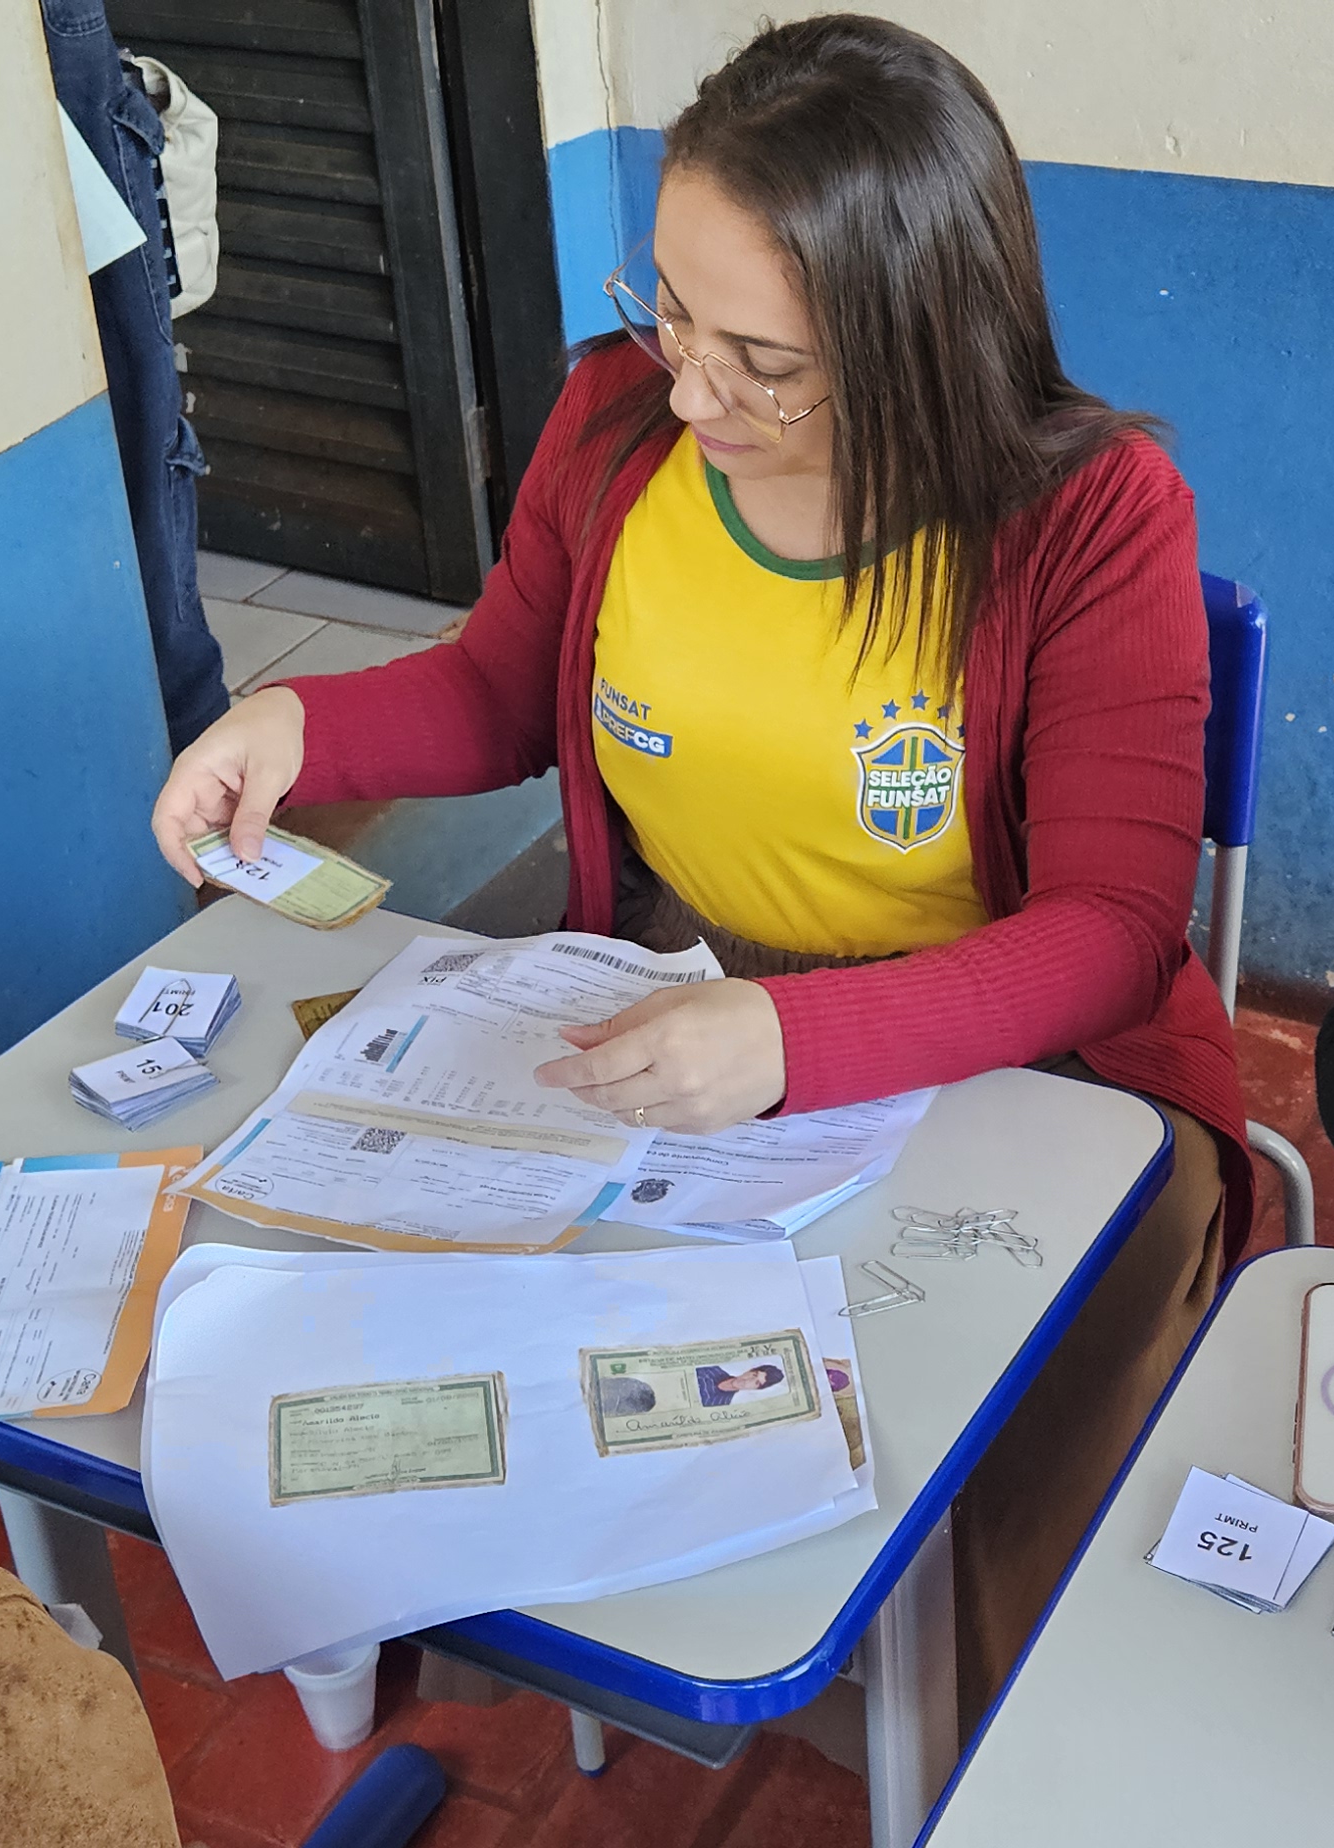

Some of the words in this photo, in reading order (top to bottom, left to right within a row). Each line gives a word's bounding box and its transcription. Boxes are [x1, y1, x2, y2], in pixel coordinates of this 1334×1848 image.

[599, 676, 653, 722] FUNSAT
[601, 705, 667, 755] PREFCG
[867, 765, 953, 793] SELEÇÃO
[867, 784, 950, 809] FUNSAT
[150, 1000, 195, 1017] 201
[1214, 1512, 1259, 1534] PRIMT
[1197, 1530, 1253, 1562] 125
